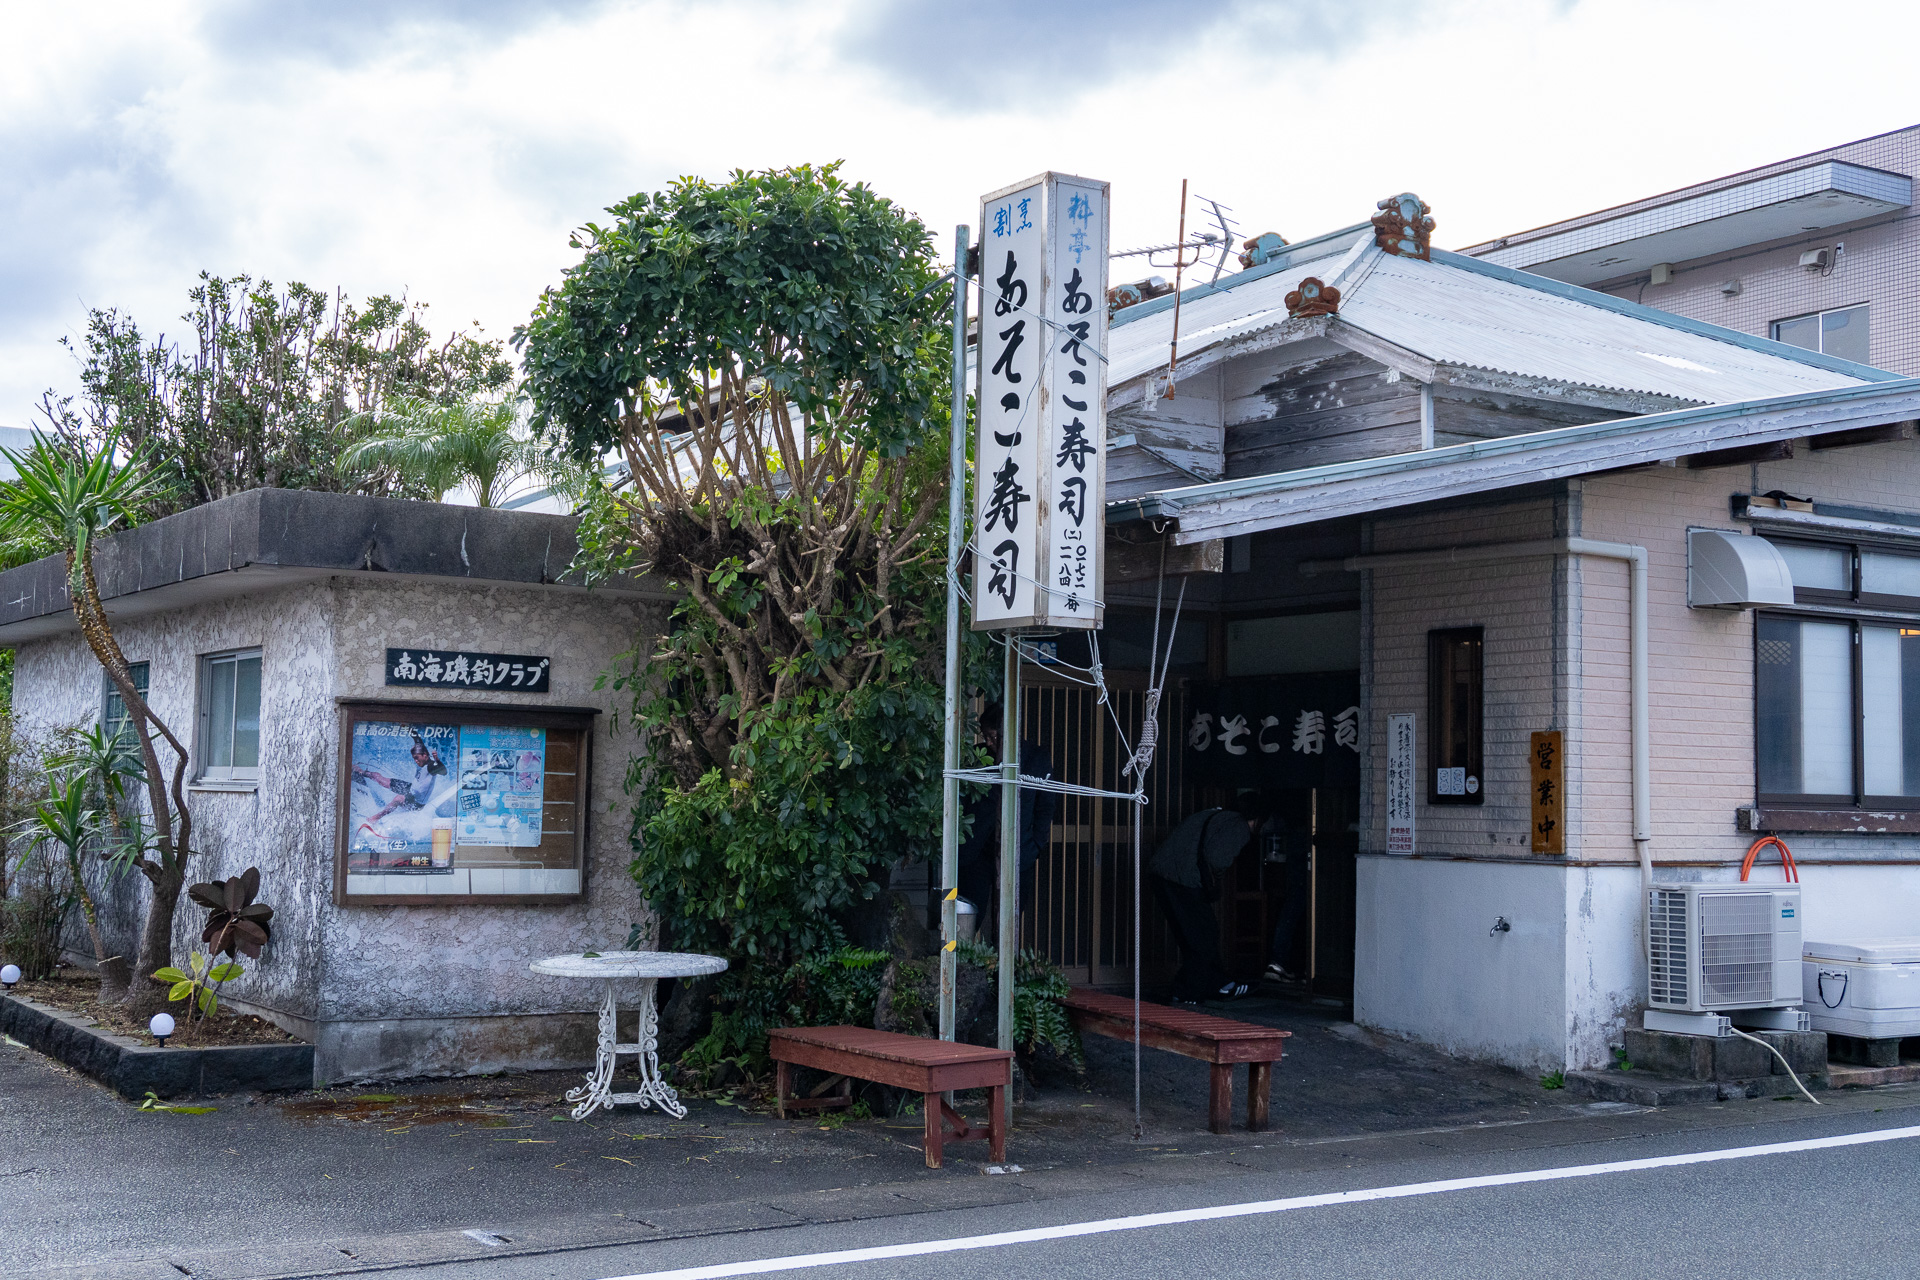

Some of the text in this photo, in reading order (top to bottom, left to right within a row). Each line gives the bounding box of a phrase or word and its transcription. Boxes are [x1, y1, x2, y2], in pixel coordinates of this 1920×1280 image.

[993, 197, 1033, 239] 割烹
[1067, 190, 1095, 264] 料亭
[984, 249, 1032, 612] あそこ寿司
[1056, 267, 1097, 529] あそこ寿司
[394, 651, 549, 686] 南海磯釣クラブ
[1188, 705, 1361, 756] あそこ寿司
[1536, 741, 1555, 845] 営業中
